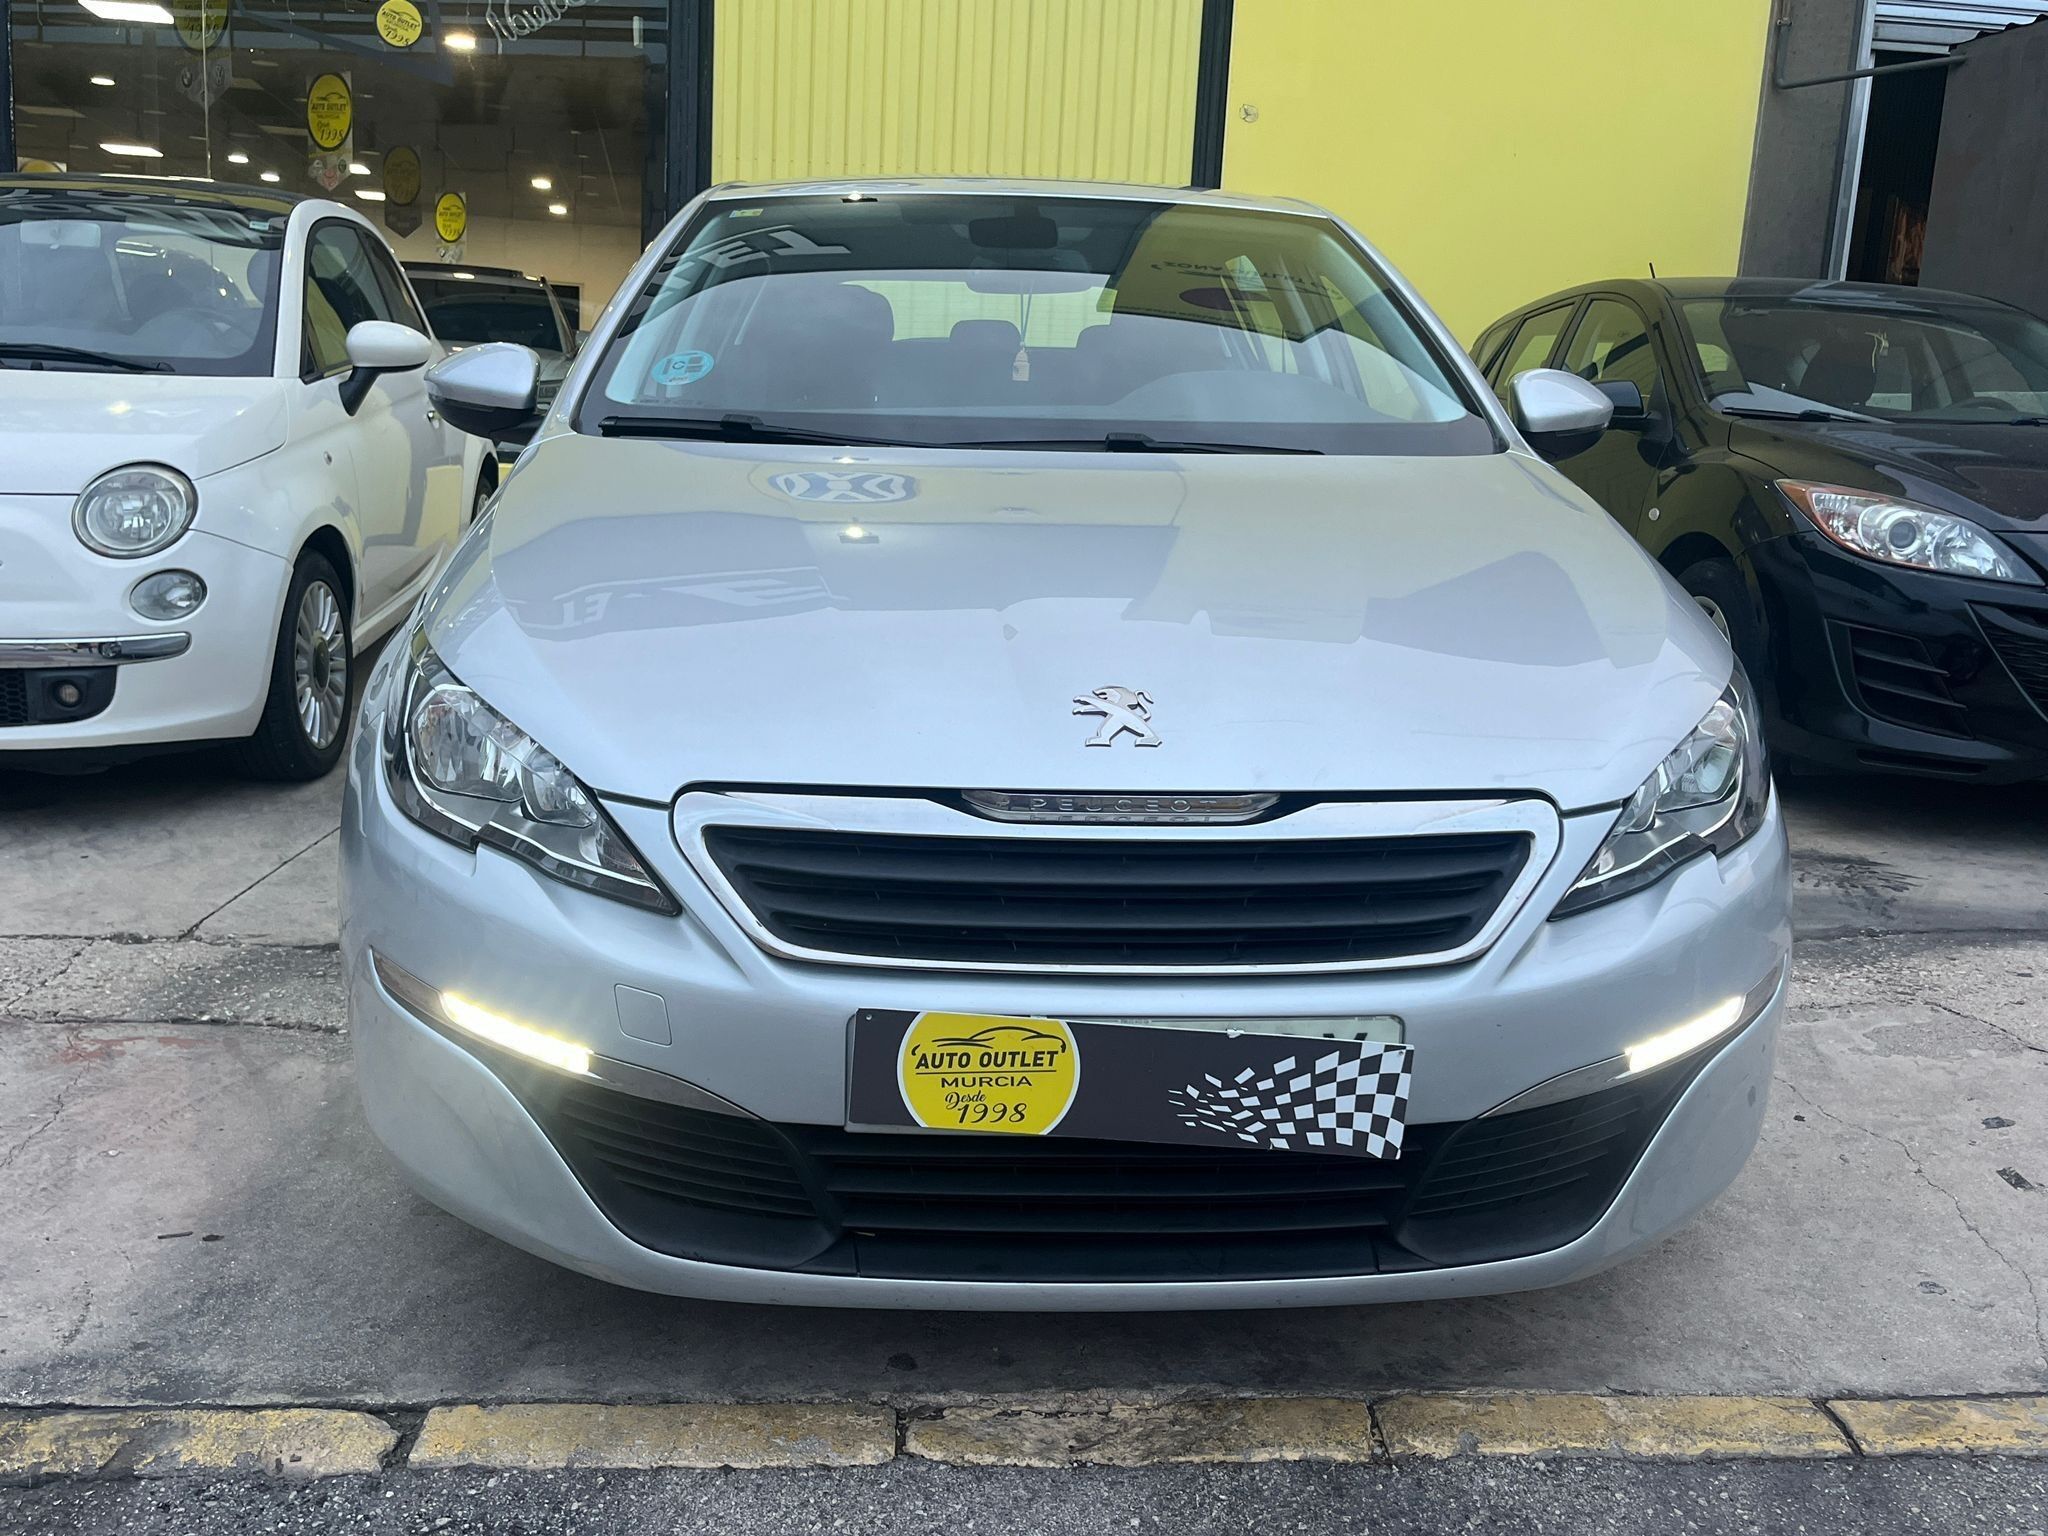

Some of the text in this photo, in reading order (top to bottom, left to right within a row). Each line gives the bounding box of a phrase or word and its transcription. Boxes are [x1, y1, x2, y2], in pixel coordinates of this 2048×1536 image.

[915, 1050, 1059, 1070] AUTO OUTLET
[941, 1075, 1033, 1088] MURCIA
[945, 1090, 986, 1110] Desde
[957, 1102, 1028, 1124] 1998
